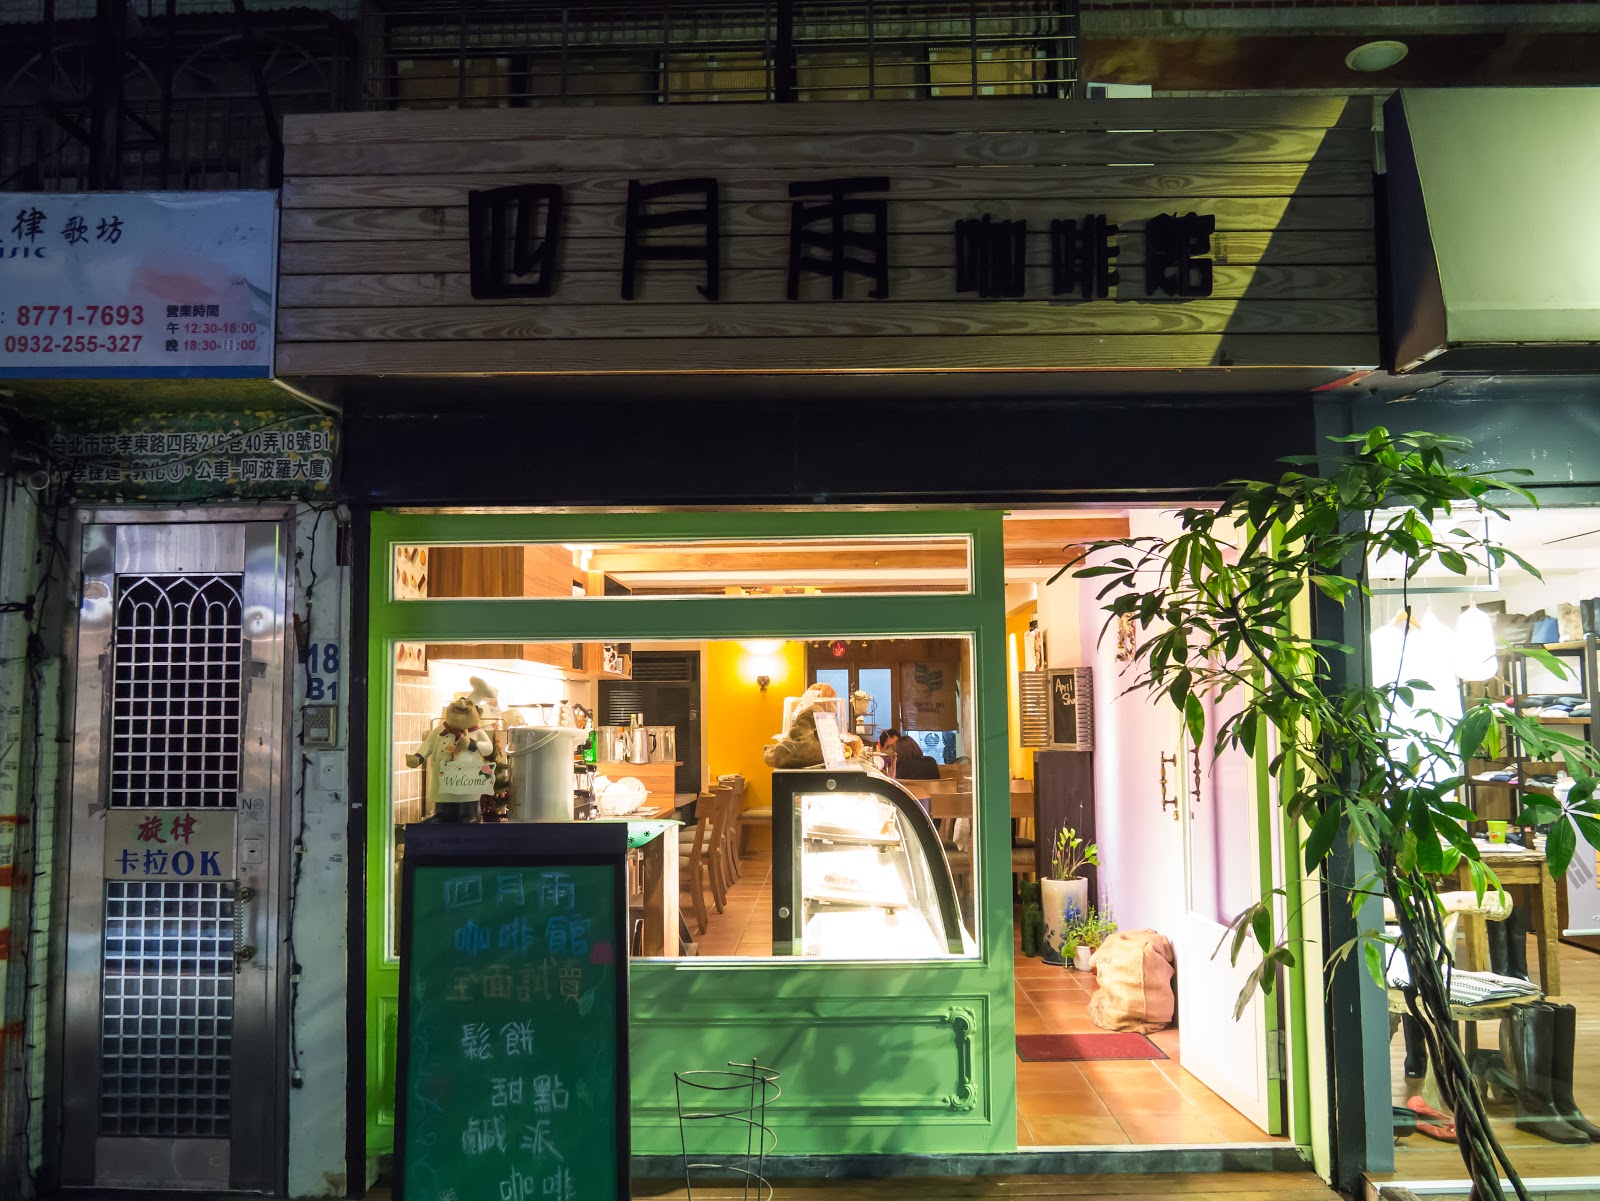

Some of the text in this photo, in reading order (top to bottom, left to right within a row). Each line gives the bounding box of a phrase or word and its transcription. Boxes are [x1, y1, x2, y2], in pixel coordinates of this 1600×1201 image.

[469, 177, 890, 302] 四月雨
[16, 304, 144, 326] 8771-7693
[165, 304, 220, 318] 營業時間
[166, 322, 257, 336] 午 12:30-18:00
[5, 335, 143, 353] 0932-255-327
[306, 643, 339, 674] 18
[307, 677, 338, 701] B1
[1055, 678, 1073, 695] April
[443, 775, 488, 788] Welcome
[137, 812, 198, 845] 旋律
[114, 848, 222, 876] 卡拉OK
[443, 871, 576, 909] 四月雨
[453, 913, 592, 956] 咖啡館
[460, 1018, 535, 1060] 鬆餅
[491, 1074, 570, 1113] 甜點
[499, 1164, 577, 1201] 咖啡
